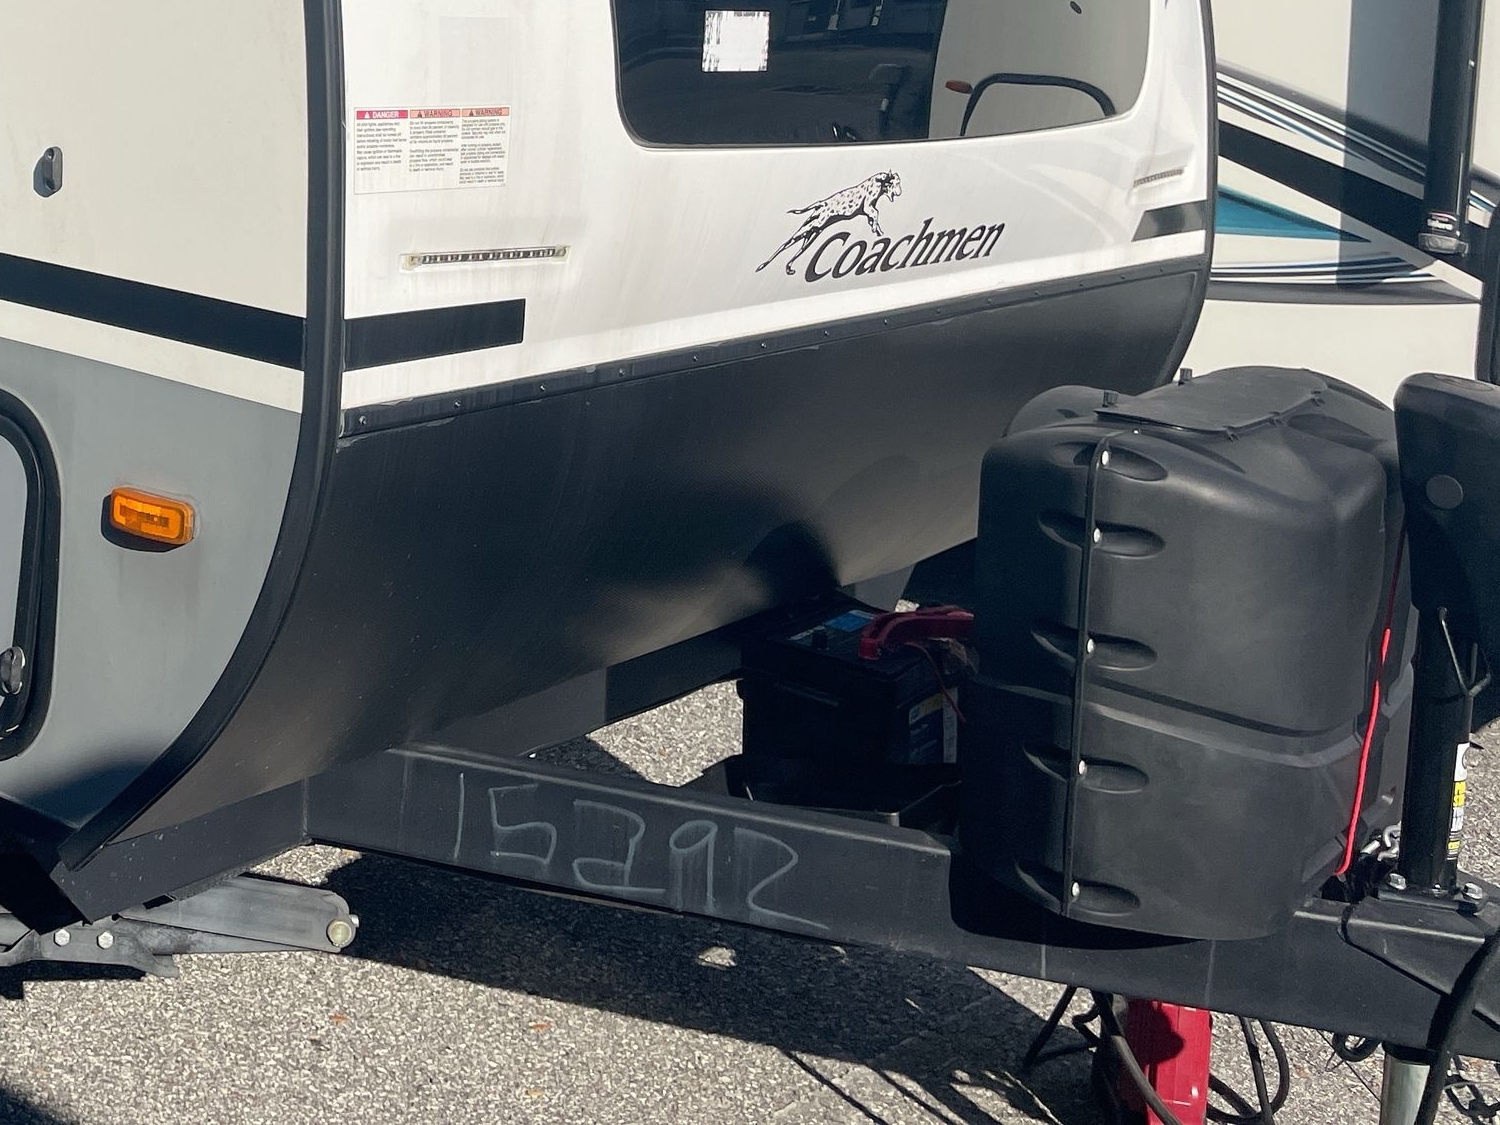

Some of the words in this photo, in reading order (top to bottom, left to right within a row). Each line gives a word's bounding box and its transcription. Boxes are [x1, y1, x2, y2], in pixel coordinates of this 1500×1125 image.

[372, 111, 399, 119] DANGER
[424, 109, 453, 117] WARNING
[475, 108, 503, 116] WARNING
[804, 217, 1006, 283] Coachmen
[453, 772, 830, 930] 15292
